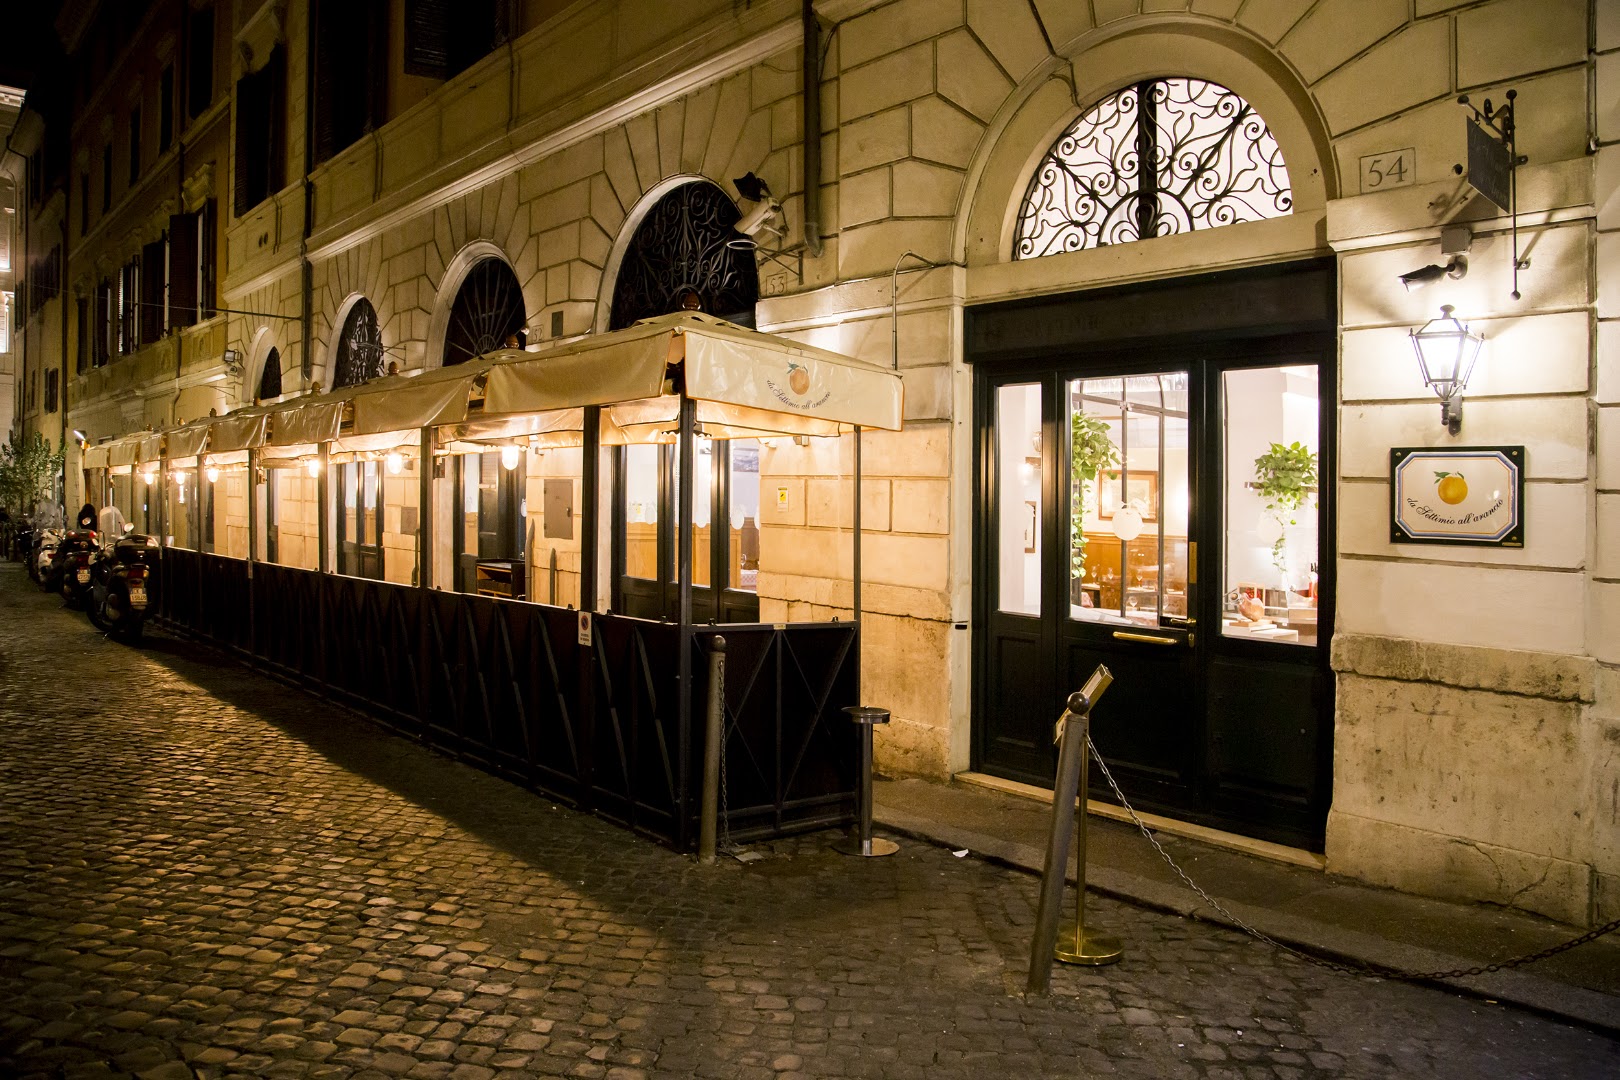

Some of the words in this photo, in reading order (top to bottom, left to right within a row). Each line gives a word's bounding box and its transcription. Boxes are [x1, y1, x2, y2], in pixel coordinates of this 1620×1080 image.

[1368, 155, 1408, 187] 54
[769, 276, 785, 295] 53
[1407, 497, 1418, 508] da
[1416, 505, 1455, 525] Settimio
